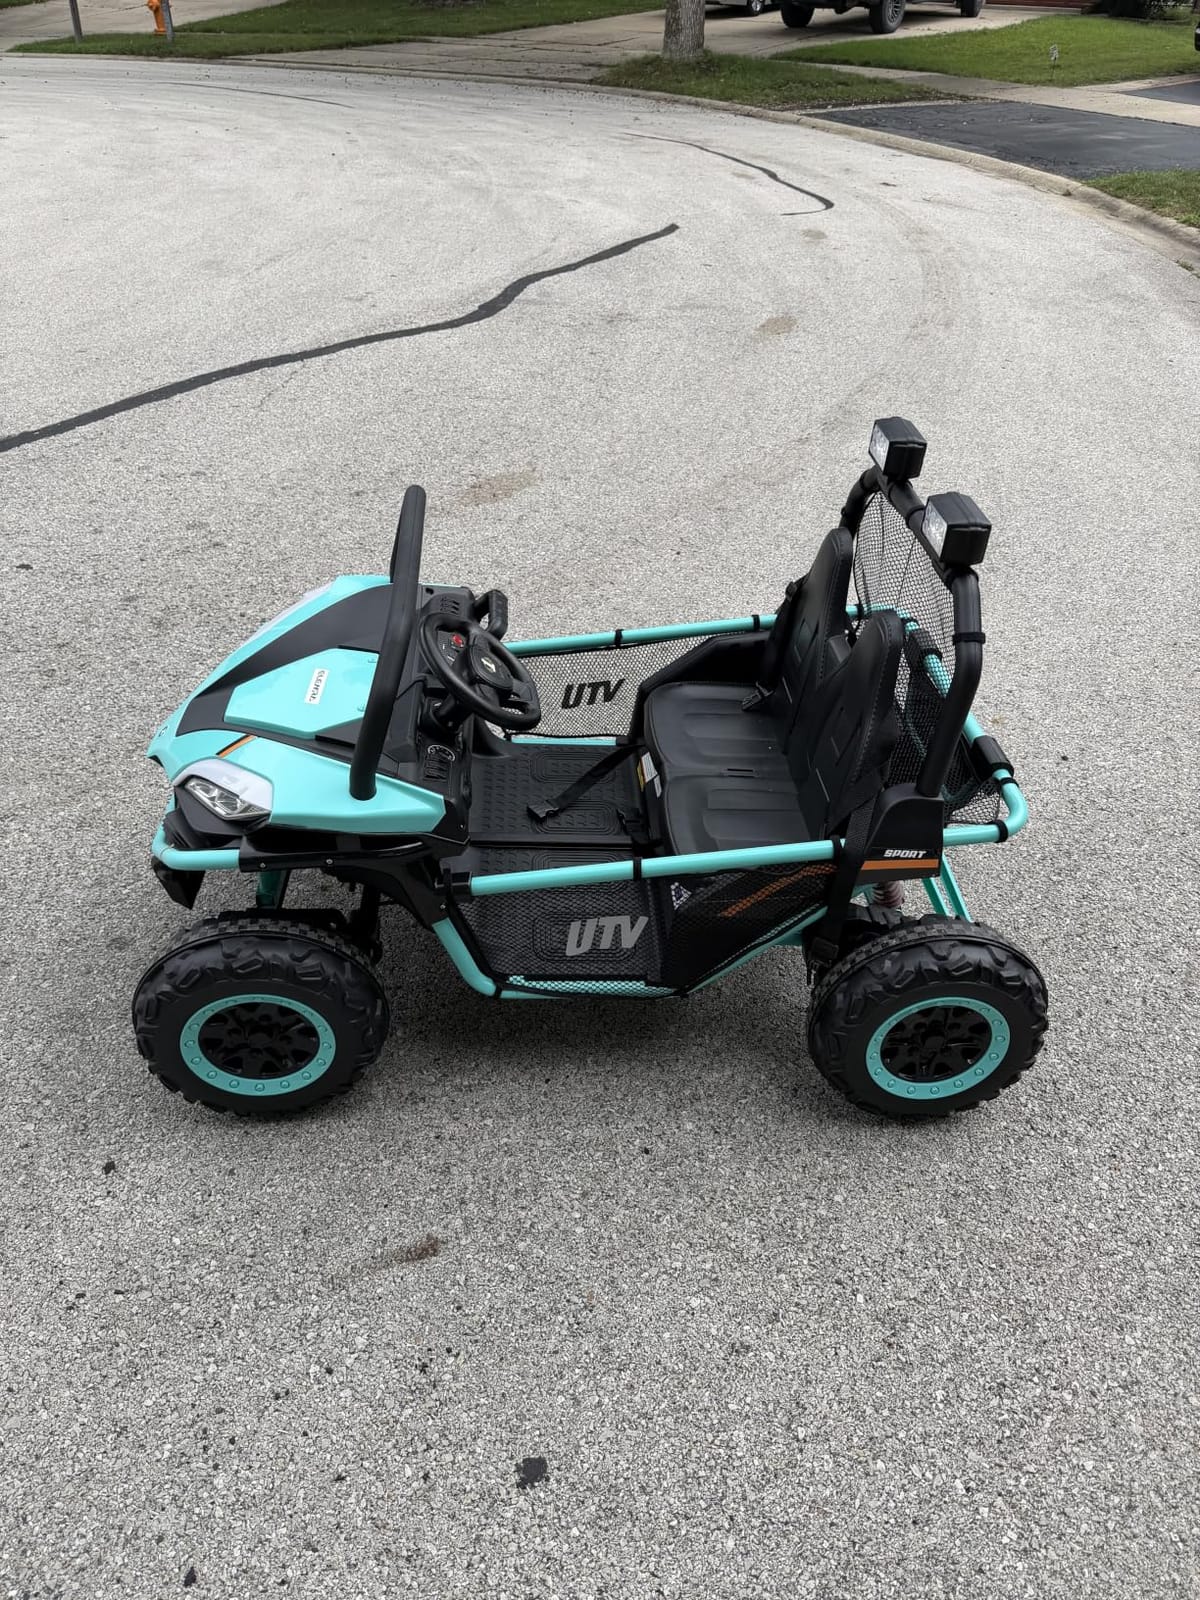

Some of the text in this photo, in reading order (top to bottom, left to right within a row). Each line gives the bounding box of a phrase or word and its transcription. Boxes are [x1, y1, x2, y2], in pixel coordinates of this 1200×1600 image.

[561, 679, 626, 709] UTV
[883, 849, 927, 858] SPORT
[565, 915, 649, 957] UTV
